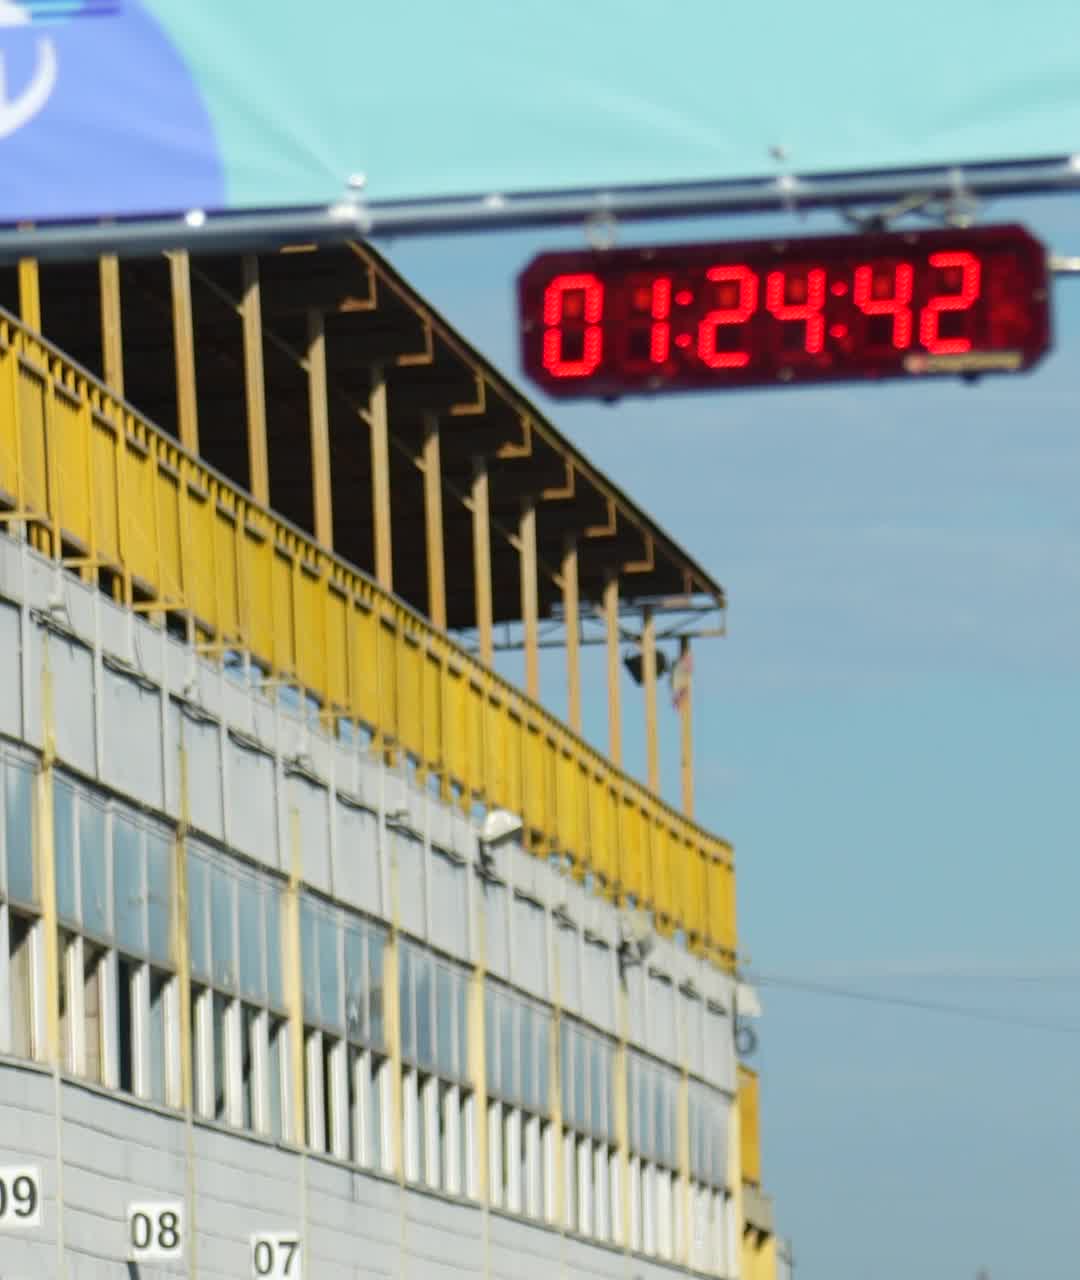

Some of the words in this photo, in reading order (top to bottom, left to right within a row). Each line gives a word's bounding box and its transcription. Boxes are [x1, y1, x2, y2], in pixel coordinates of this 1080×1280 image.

[543, 251, 981, 378] 01:24:42
[130, 1211, 180, 1249] 08
[254, 1240, 299, 1276] 07
